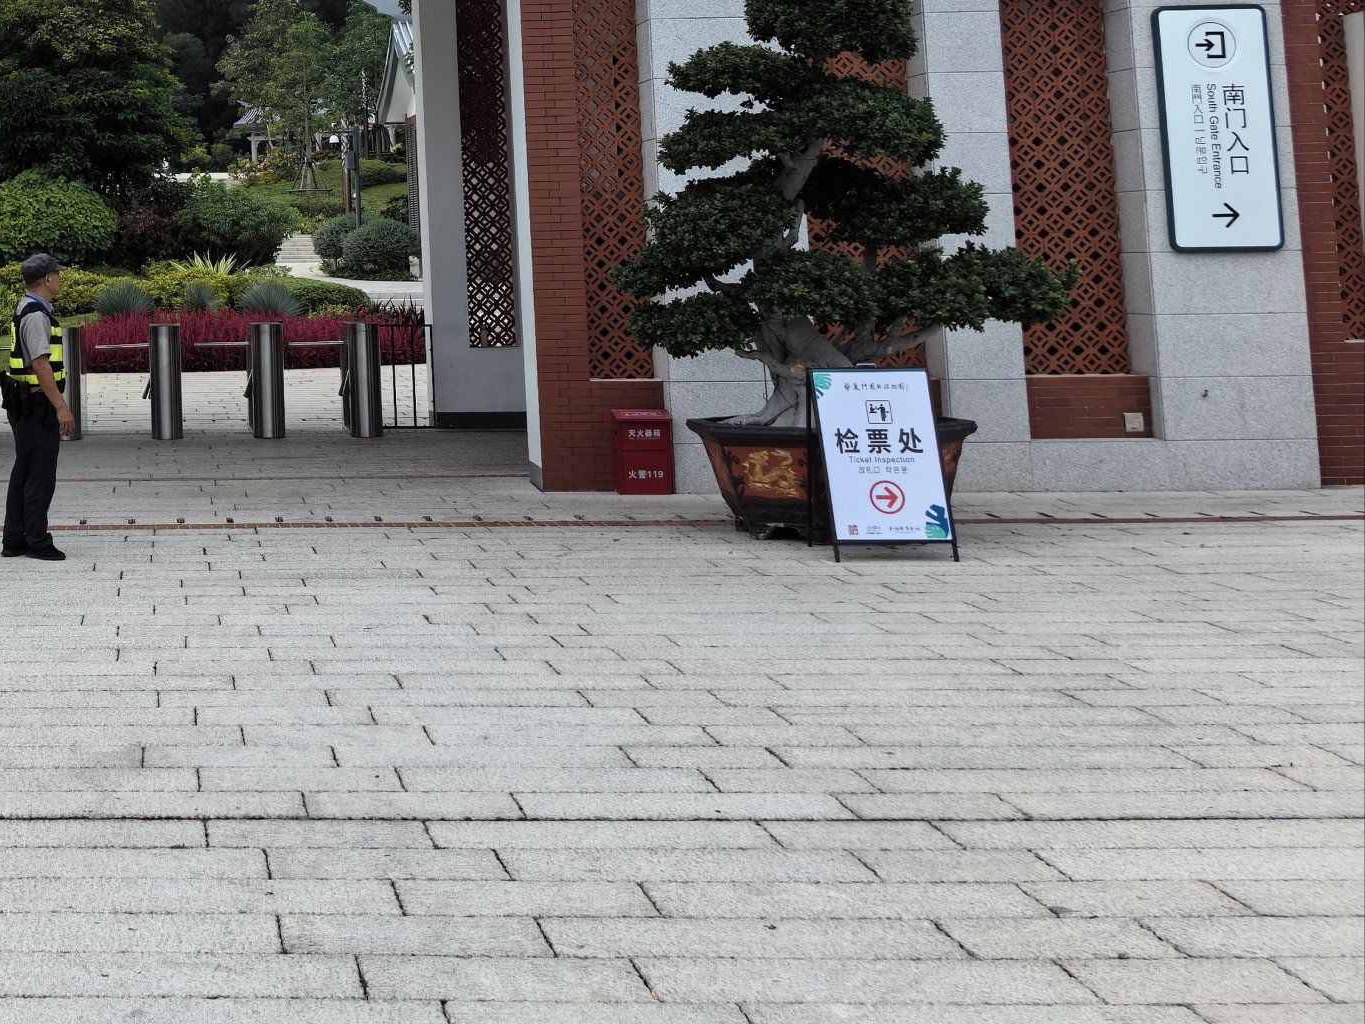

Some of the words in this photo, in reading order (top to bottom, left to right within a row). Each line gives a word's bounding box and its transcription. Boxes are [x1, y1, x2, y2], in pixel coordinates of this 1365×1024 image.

[1206, 83, 1218, 113] South
[1209, 115, 1220, 140] Gate
[1222, 83, 1250, 175] 南门入口
[1211, 143, 1222, 189] Entrance
[834, 428, 924, 454] 检票处
[874, 456, 915, 464] Inspection
